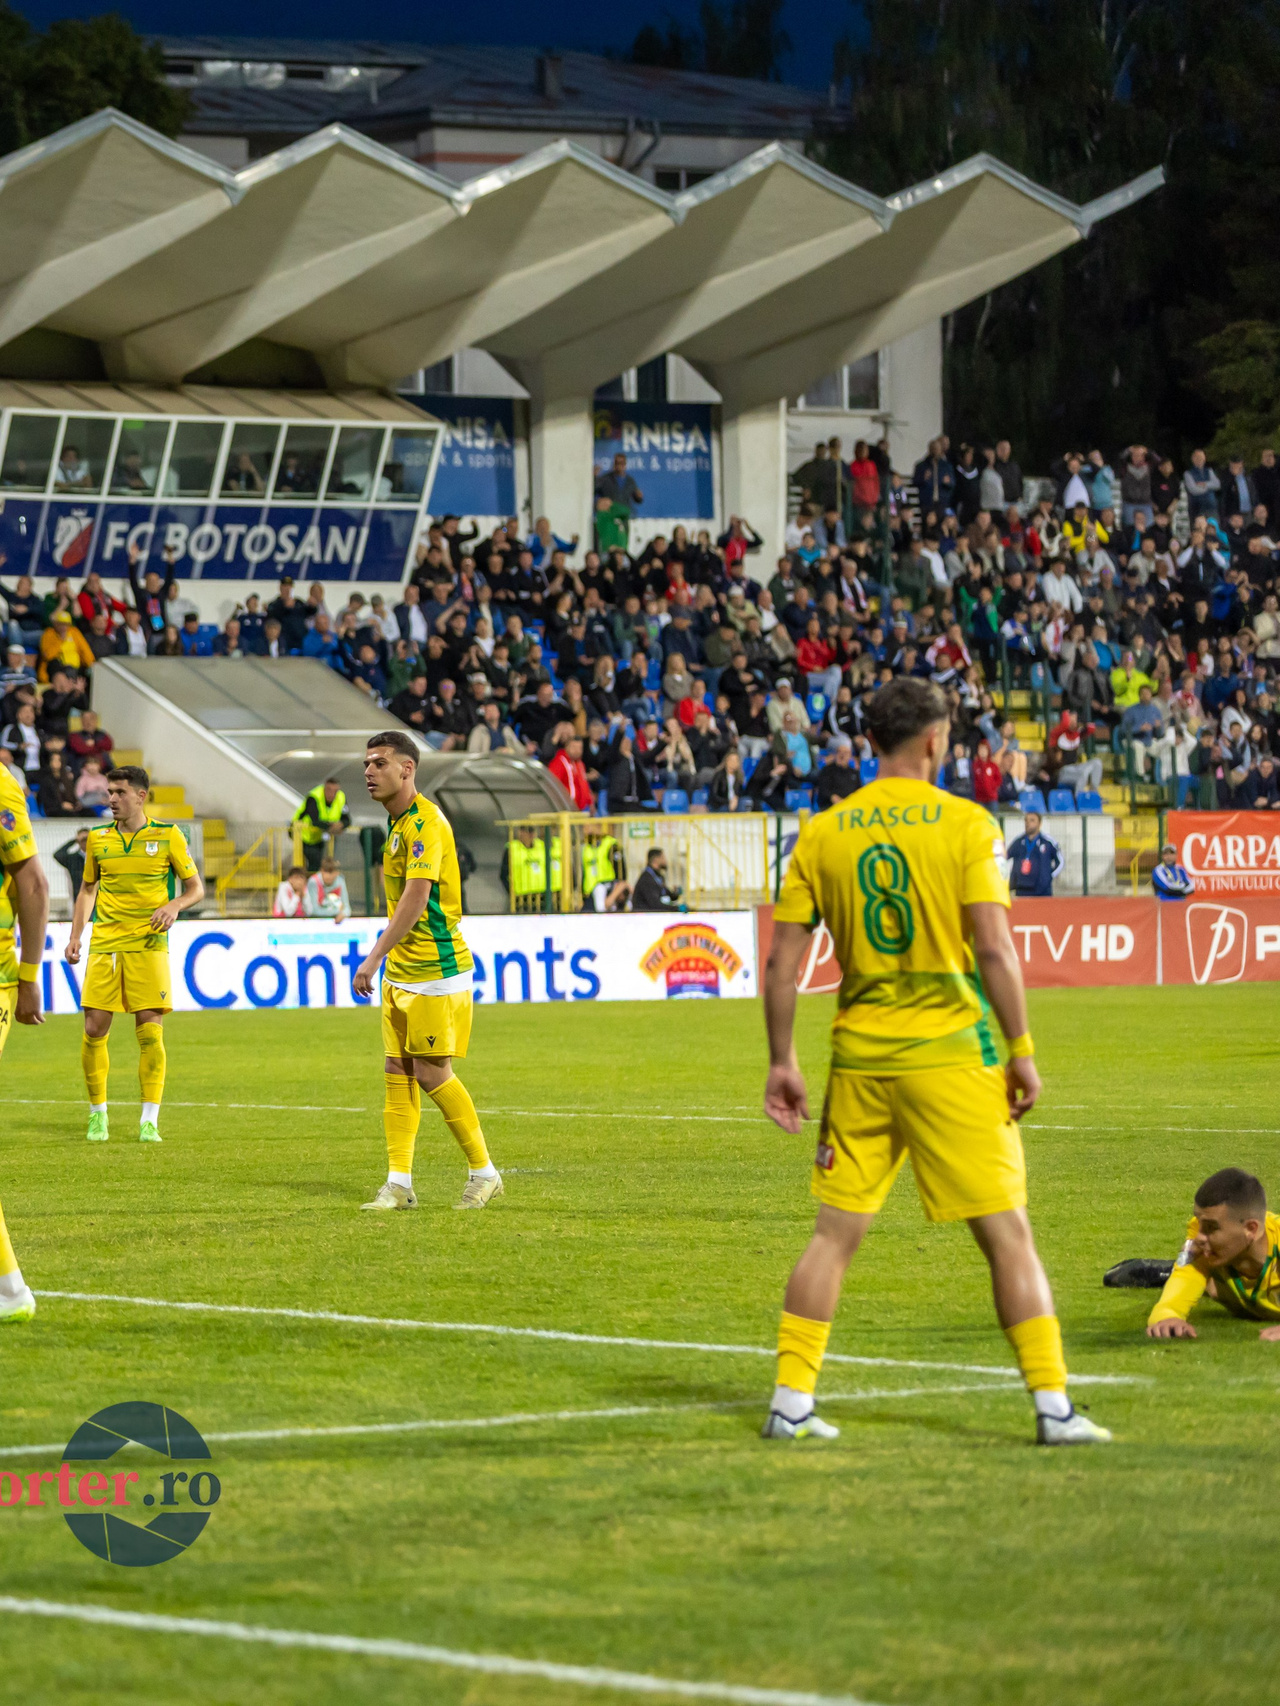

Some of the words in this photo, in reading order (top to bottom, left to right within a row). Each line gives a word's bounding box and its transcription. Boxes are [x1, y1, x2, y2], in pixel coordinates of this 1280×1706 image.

[452, 450, 463, 467] &
[650, 455, 661, 472] &
[666, 456, 710, 473] sports
[102, 521, 156, 562] FC
[164, 521, 370, 573] BOTOȘANI
[835, 804, 942, 832] TRASCU
[857, 843, 916, 956] 8
[1013, 924, 1074, 963] TV
[1080, 924, 1134, 962] HD
[183, 930, 601, 1009] Contnts
